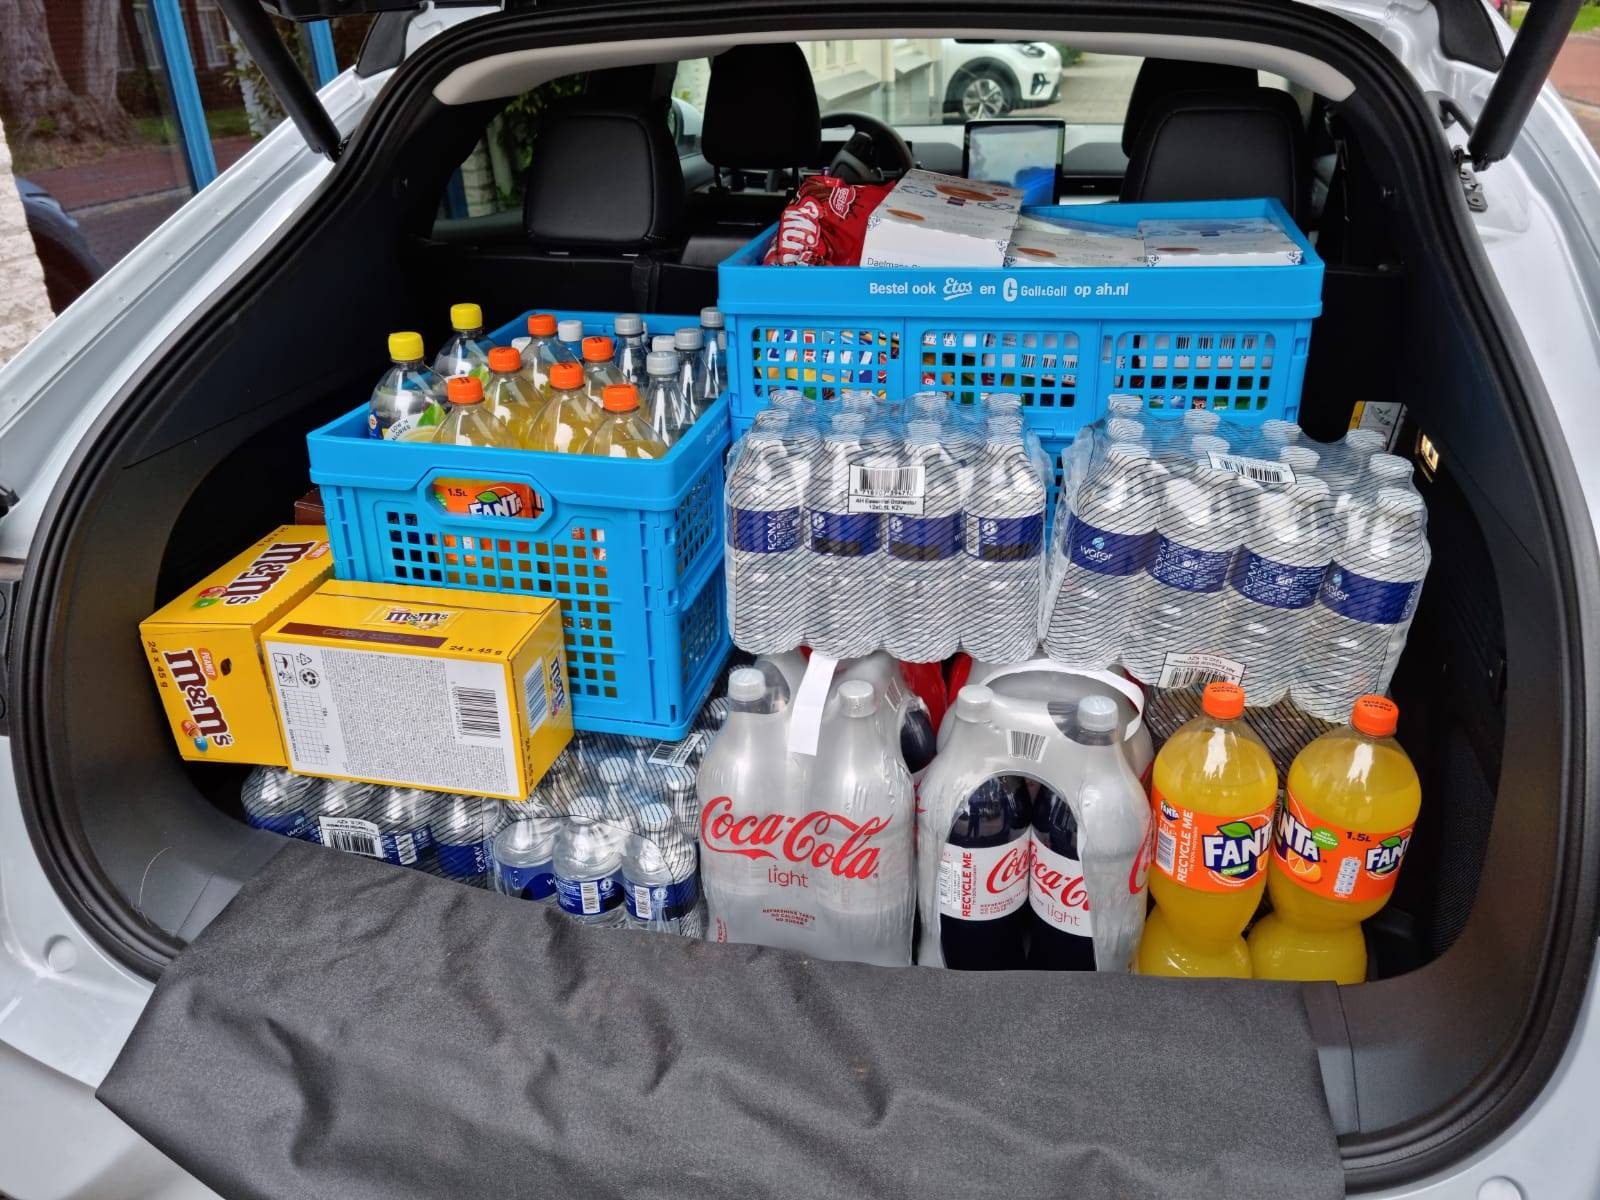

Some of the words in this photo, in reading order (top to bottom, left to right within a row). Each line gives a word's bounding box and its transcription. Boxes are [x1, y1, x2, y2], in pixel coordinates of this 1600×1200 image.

[870, 282, 908, 294] Bestel
[912, 282, 936, 294] ook
[943, 277, 973, 300] Etos
[980, 284, 996, 295] en
[1021, 285, 1067, 297] Gall&Gall
[1074, 284, 1091, 298] op
[1095, 283, 1129, 296] ah.nl
[447, 488, 468, 498] 1.5L
[469, 493, 523, 517] FANTA
[157, 666, 167, 679] 45
[1183, 809, 1194, 829] ME
[701, 796, 893, 879] Coca-Cola
[1204, 821, 1273, 867] FANT
[1346, 831, 1371, 842] 1.5L
[962, 852, 973, 870] ME
[1177, 831, 1191, 882] RECYCLE
[768, 865, 809, 888] light
[962, 871, 973, 918] RECYCLE
[1047, 903, 1081, 927] light
